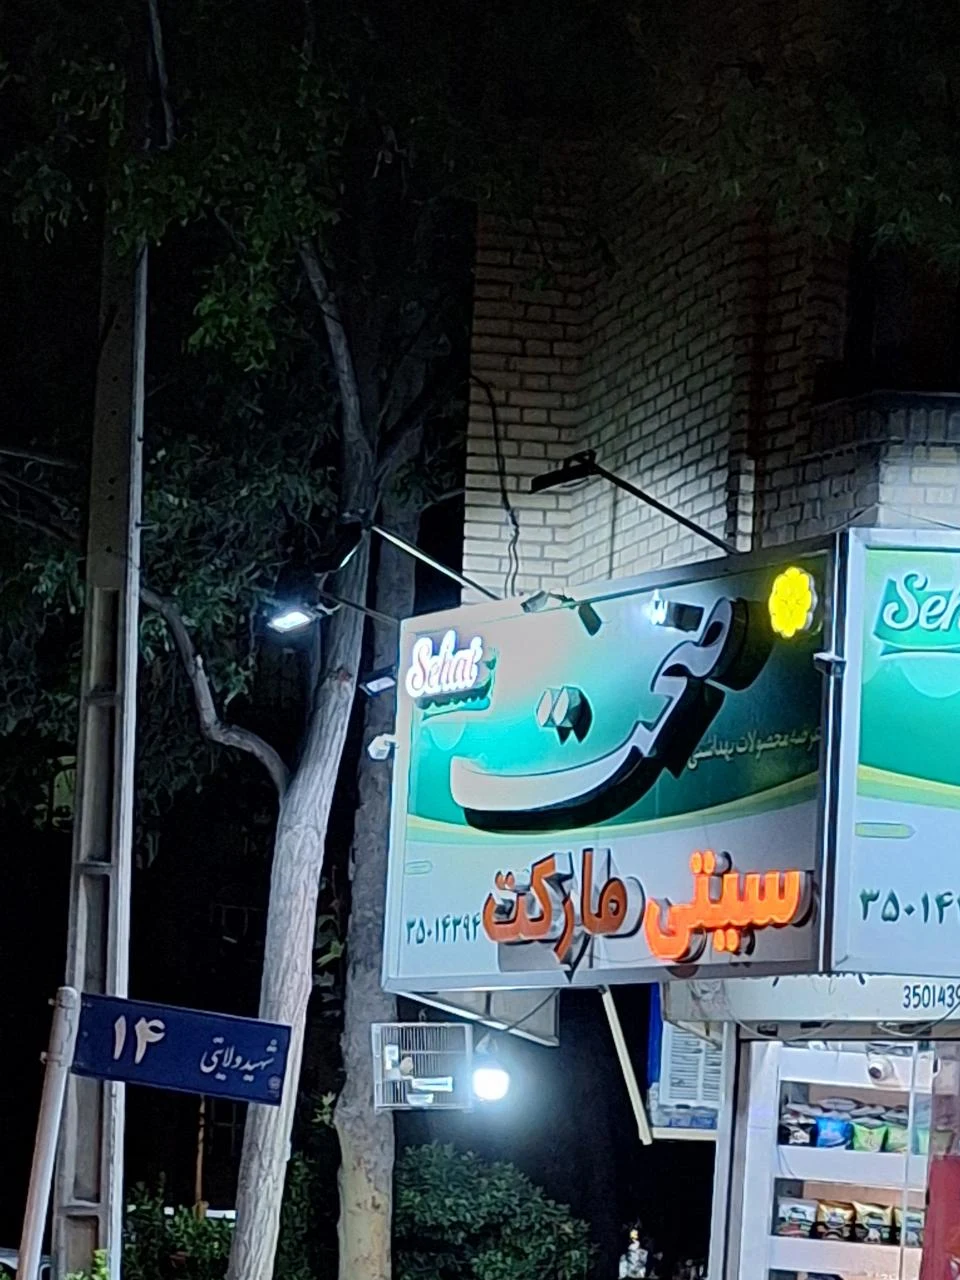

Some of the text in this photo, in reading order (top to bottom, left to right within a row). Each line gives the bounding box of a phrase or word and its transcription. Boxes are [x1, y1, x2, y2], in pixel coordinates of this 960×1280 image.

[405, 629, 483, 698] Sehat
[406, 912, 482, 946] ۳۵۰۱۴۳۹۴
[482, 847, 814, 968] سیتی مارکت
[113, 1014, 166, 1065] ۱۴
[200, 1036, 276, 1083] شهید ولایتی
